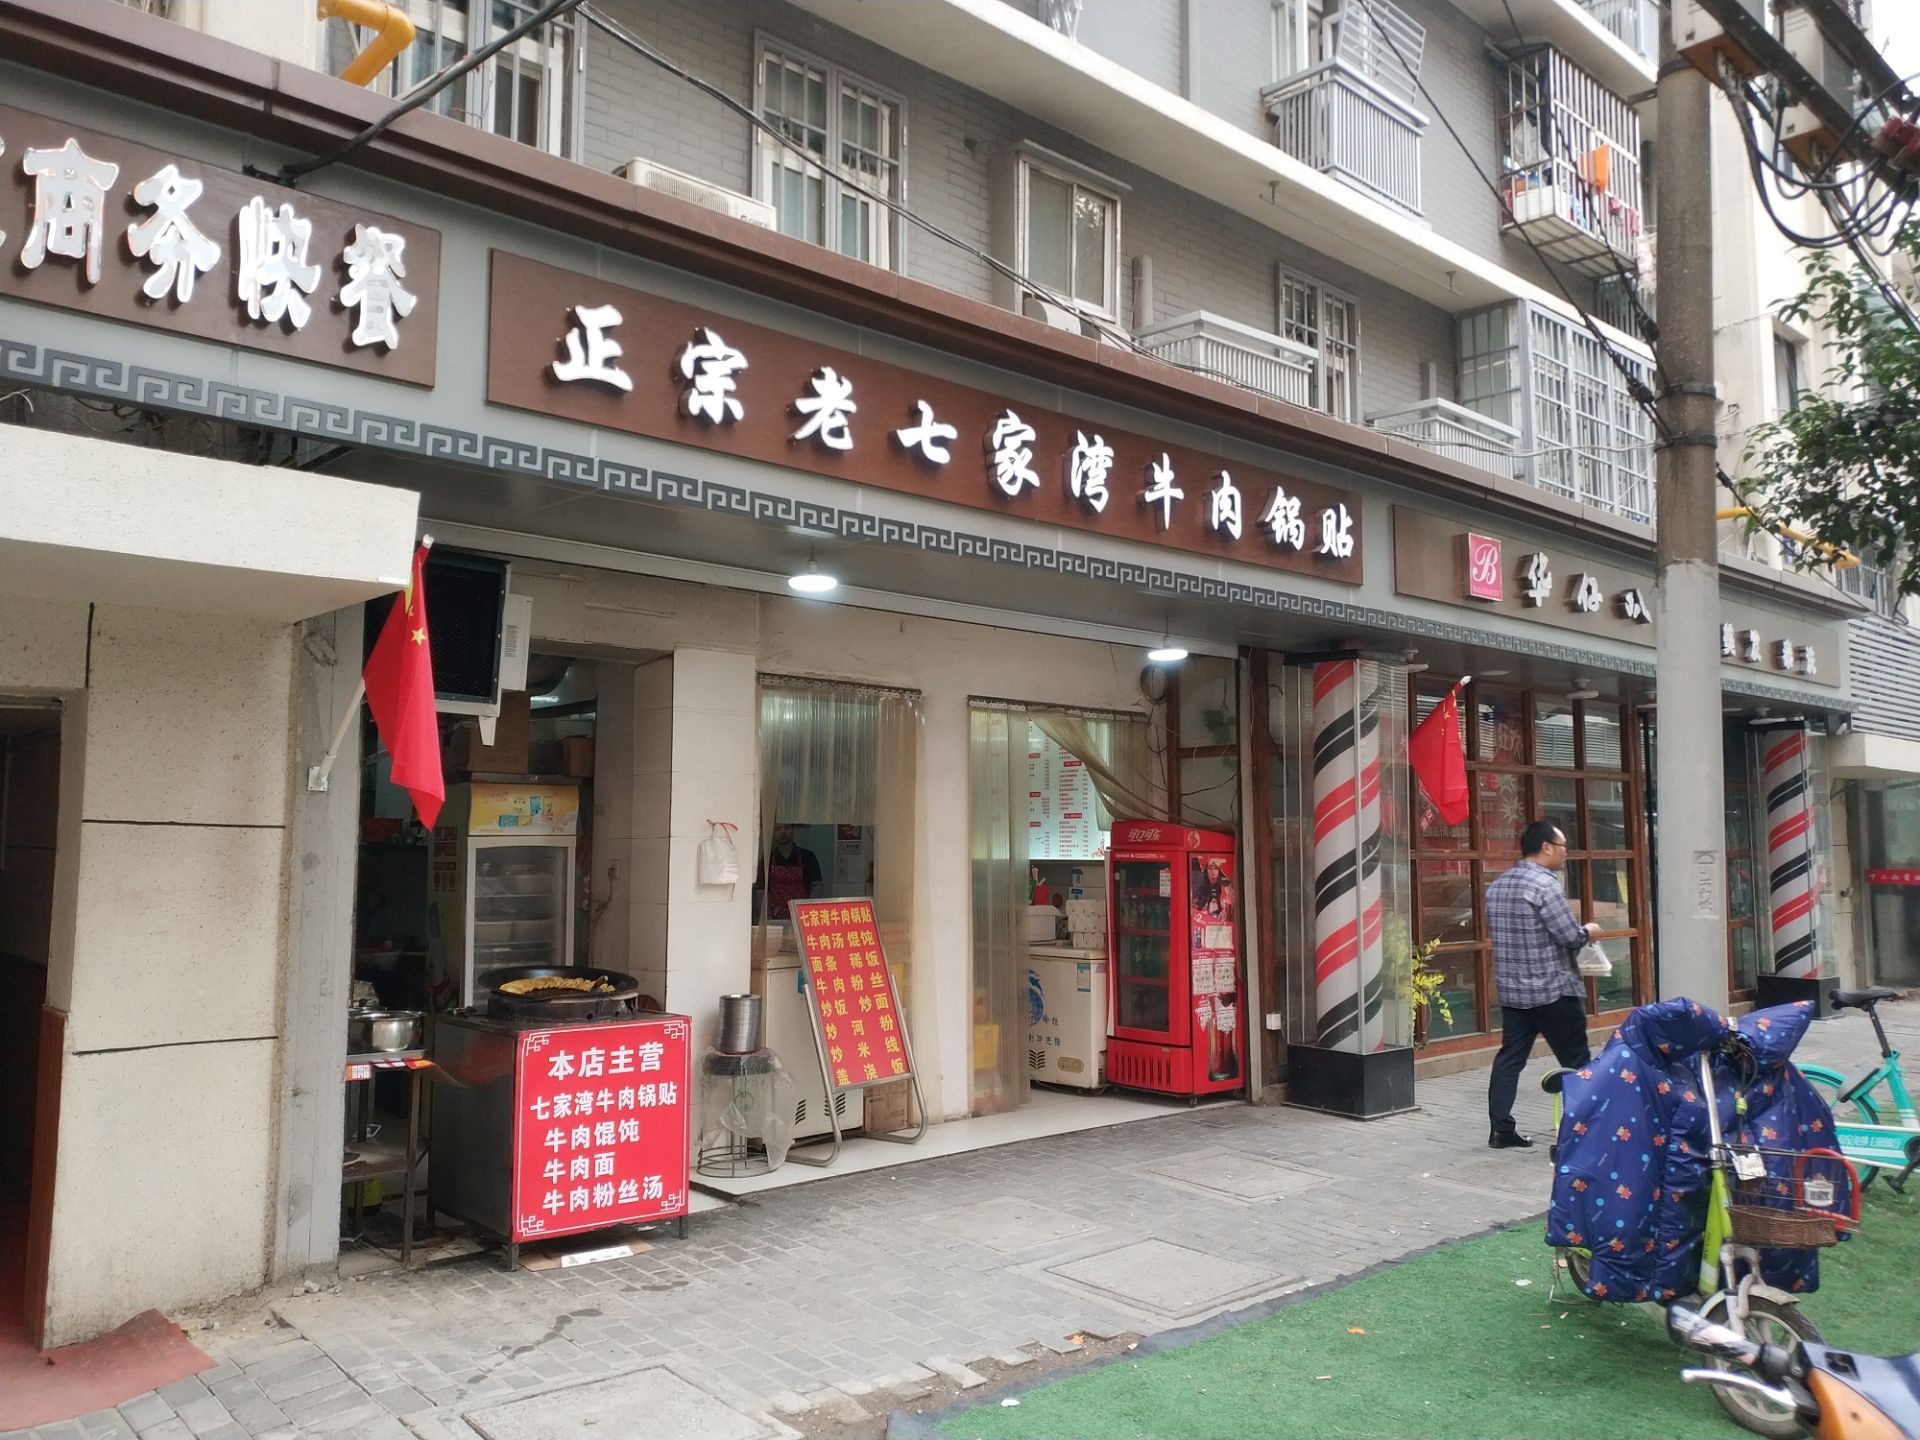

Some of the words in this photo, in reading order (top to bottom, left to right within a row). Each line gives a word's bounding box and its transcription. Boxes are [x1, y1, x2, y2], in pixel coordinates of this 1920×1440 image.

[0, 136, 417, 351] 商务快餐
[551, 304, 1355, 560] 正宗老七家湾牛肉锅贴
[1472, 543, 1499, 585] B
[799, 907, 872, 928] 七家湾牛肉锅贴
[807, 932, 845, 951] 牛肉汤
[847, 929, 876, 948] 馄饨
[810, 955, 838, 973] 面条
[848, 950, 880, 970] 稀饭
[816, 971, 885, 996] 牛肉粉丝
[821, 999, 848, 1018] 炒饭
[859, 993, 890, 1014] 炒面
[547, 1041, 665, 1081] 本店主营
[530, 1080, 678, 1121] 七家湾牛肉锅贴
[543, 1117, 641, 1154] 牛肉馄饨
[542, 1151, 616, 1185] 牛肉面
[541, 1174, 664, 1216] 牛肉粉丝汤
